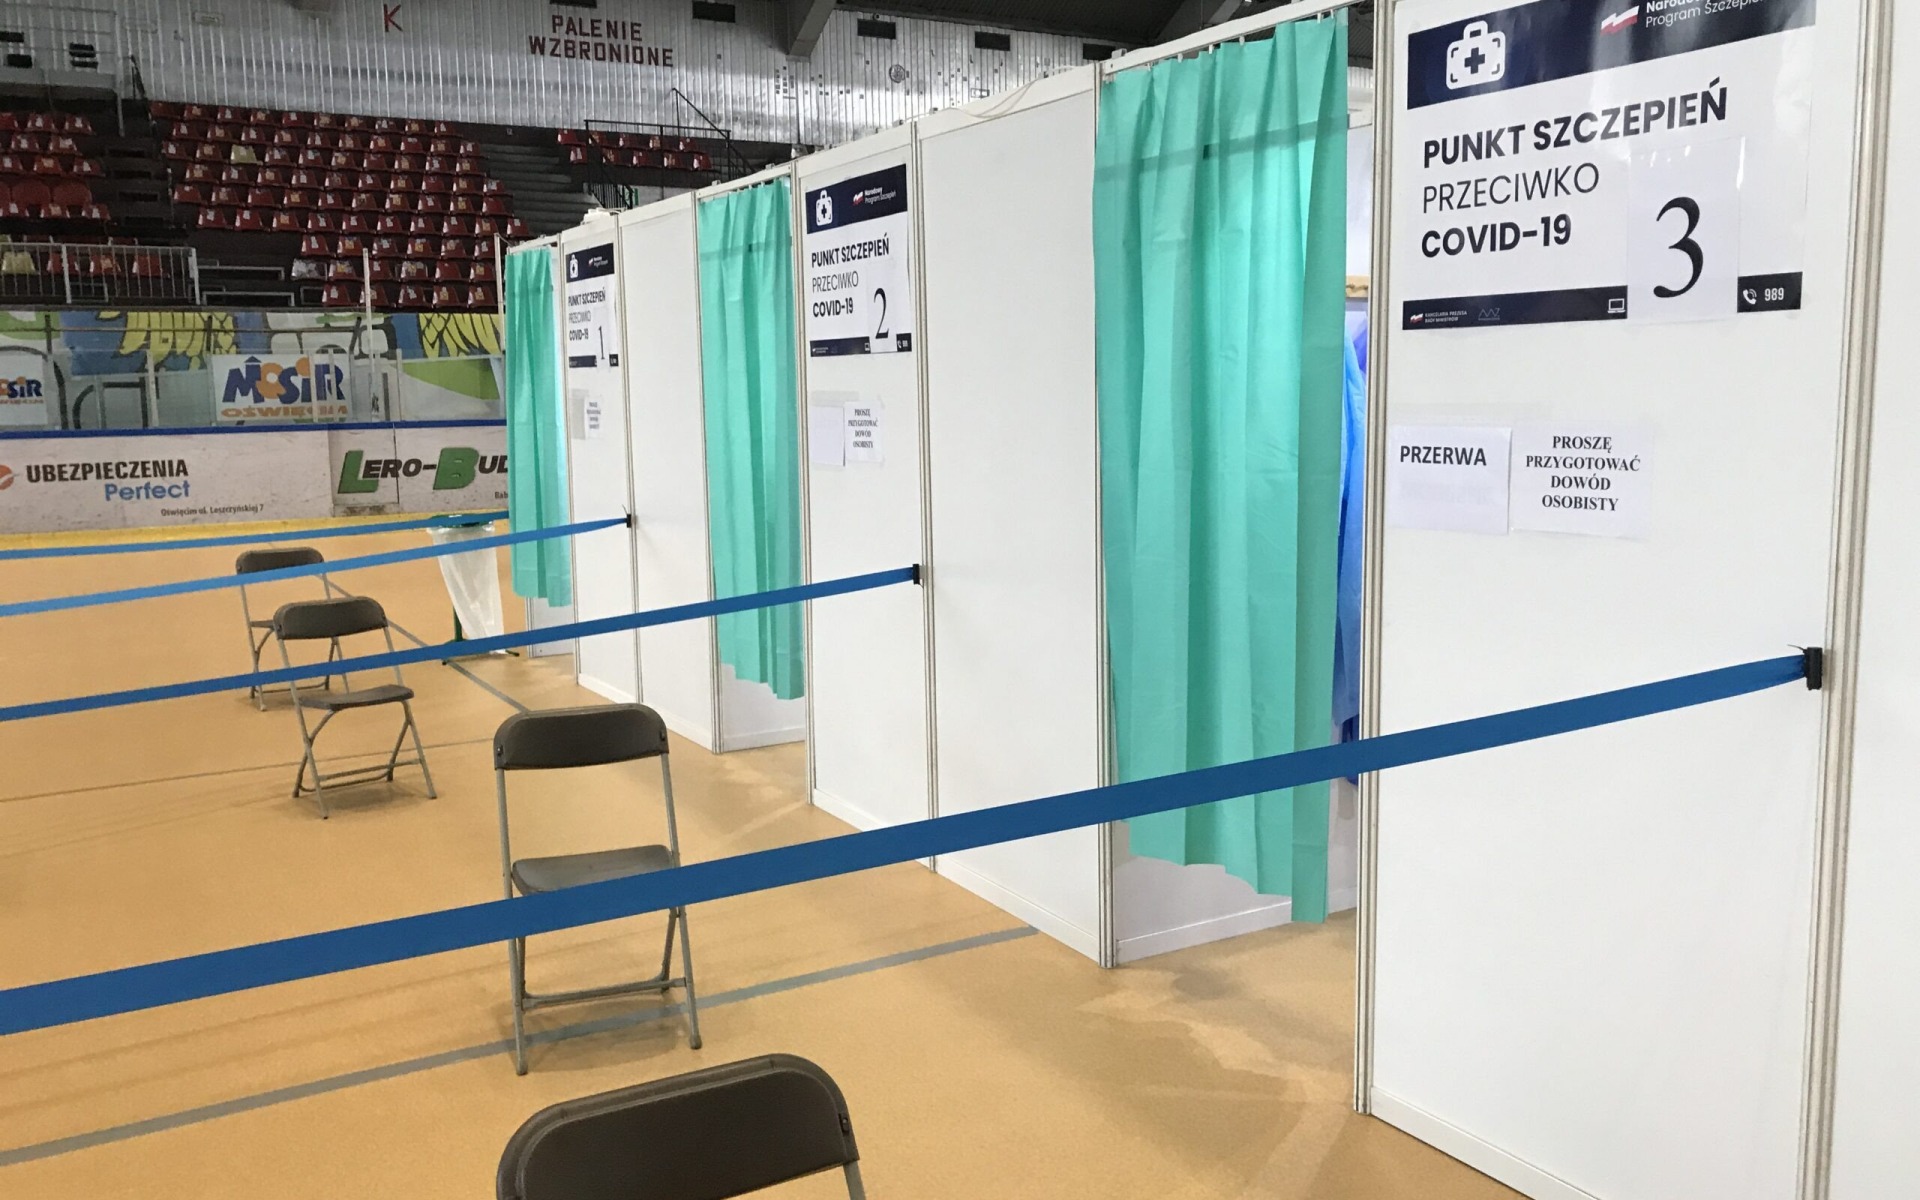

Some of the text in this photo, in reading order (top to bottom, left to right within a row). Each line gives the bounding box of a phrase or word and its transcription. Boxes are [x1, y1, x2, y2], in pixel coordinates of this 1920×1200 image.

[383, 3, 403, 33] K
[551, 14, 643, 42] PALENIE
[1645, 7, 1701, 28] Program
[528, 35, 674, 67] WZBRONIONE
[1423, 76, 1728, 168] PUNKT SZCZEPIEŃ
[1423, 162, 1600, 214] PRZECIWKO
[1421, 213, 1572, 258] COVID-19
[811, 232, 889, 268] PUNKT SZCZEPIEŃ
[1653, 196, 1704, 299] 3
[812, 270, 859, 293] PRZECIWKO
[1764, 287, 1785, 302] 989
[812, 297, 854, 318] COVID-19
[873, 287, 890, 340] 2
[598, 325, 605, 360] 1
[1399, 445, 1487, 467] PRZERWA
[1552, 435, 1612, 454] PROSZĘ
[26, 459, 189, 483] UBEZPIECZENIA
[1525, 455, 1641, 472] PRZYGOTOWAĆ
[104, 480, 191, 501] Perfect
[1550, 472, 1612, 491] DOWÓD
[160, 507, 198, 517] Oświęcim
[209, 503, 259, 514] Leszczyńskiej
[259, 503, 264, 511] 7
[1541, 494, 1619, 512] OSOBISTY
